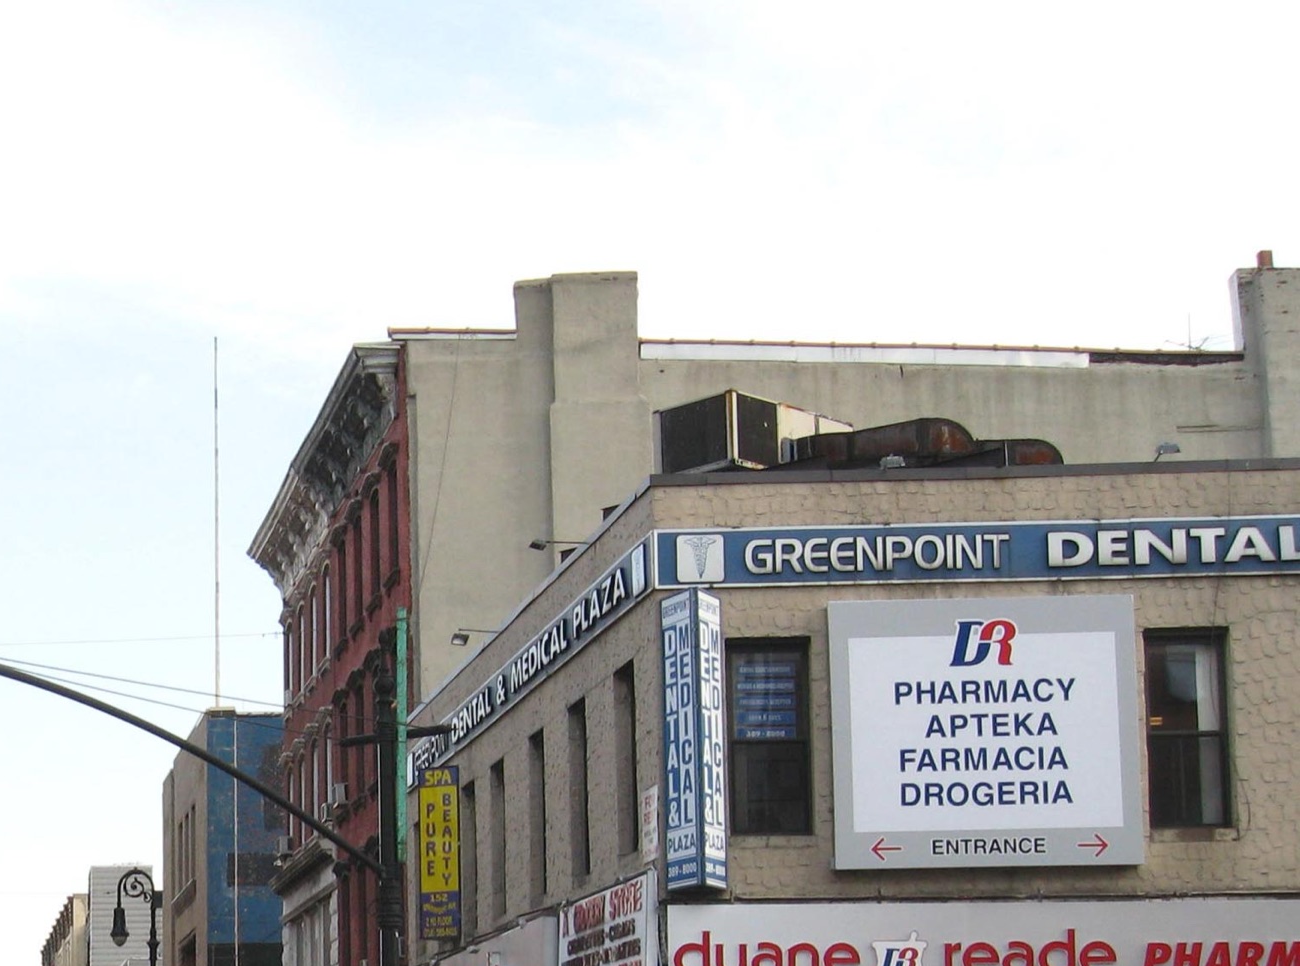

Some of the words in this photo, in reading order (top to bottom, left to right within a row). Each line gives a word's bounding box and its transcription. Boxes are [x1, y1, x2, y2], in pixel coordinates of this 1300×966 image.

[745, 533, 1011, 575] GREENPOINT
[1046, 525, 1300, 568] DENTAL
[451, 687, 493, 745] DENTAL
[496, 673, 507, 706] &
[509, 618, 569, 694] MEDICAL
[571, 567, 627, 639] PLAZA
[949, 618, 1017, 668] DR
[664, 626, 679, 800] DENTAL
[700, 621, 713, 795] DENTAL
[894, 678, 1076, 705] PHARMACY
[679, 623, 695, 825] MEDICAL
[711, 628, 723, 827] MEDICAL
[925, 712, 1058, 739] APTEKA
[425, 769, 452, 786] SPA
[899, 746, 1069, 773] FARMACIA
[900, 780, 1074, 807] DROGERIA
[426, 802, 437, 877] PURE
[442, 793, 452, 887] BEAUTY
[668, 831, 696, 855] PLAZA
[705, 832, 725, 853] PLAZA
[931, 838, 1047, 855] ENTRANCE
[608, 880, 643, 920] STORE
